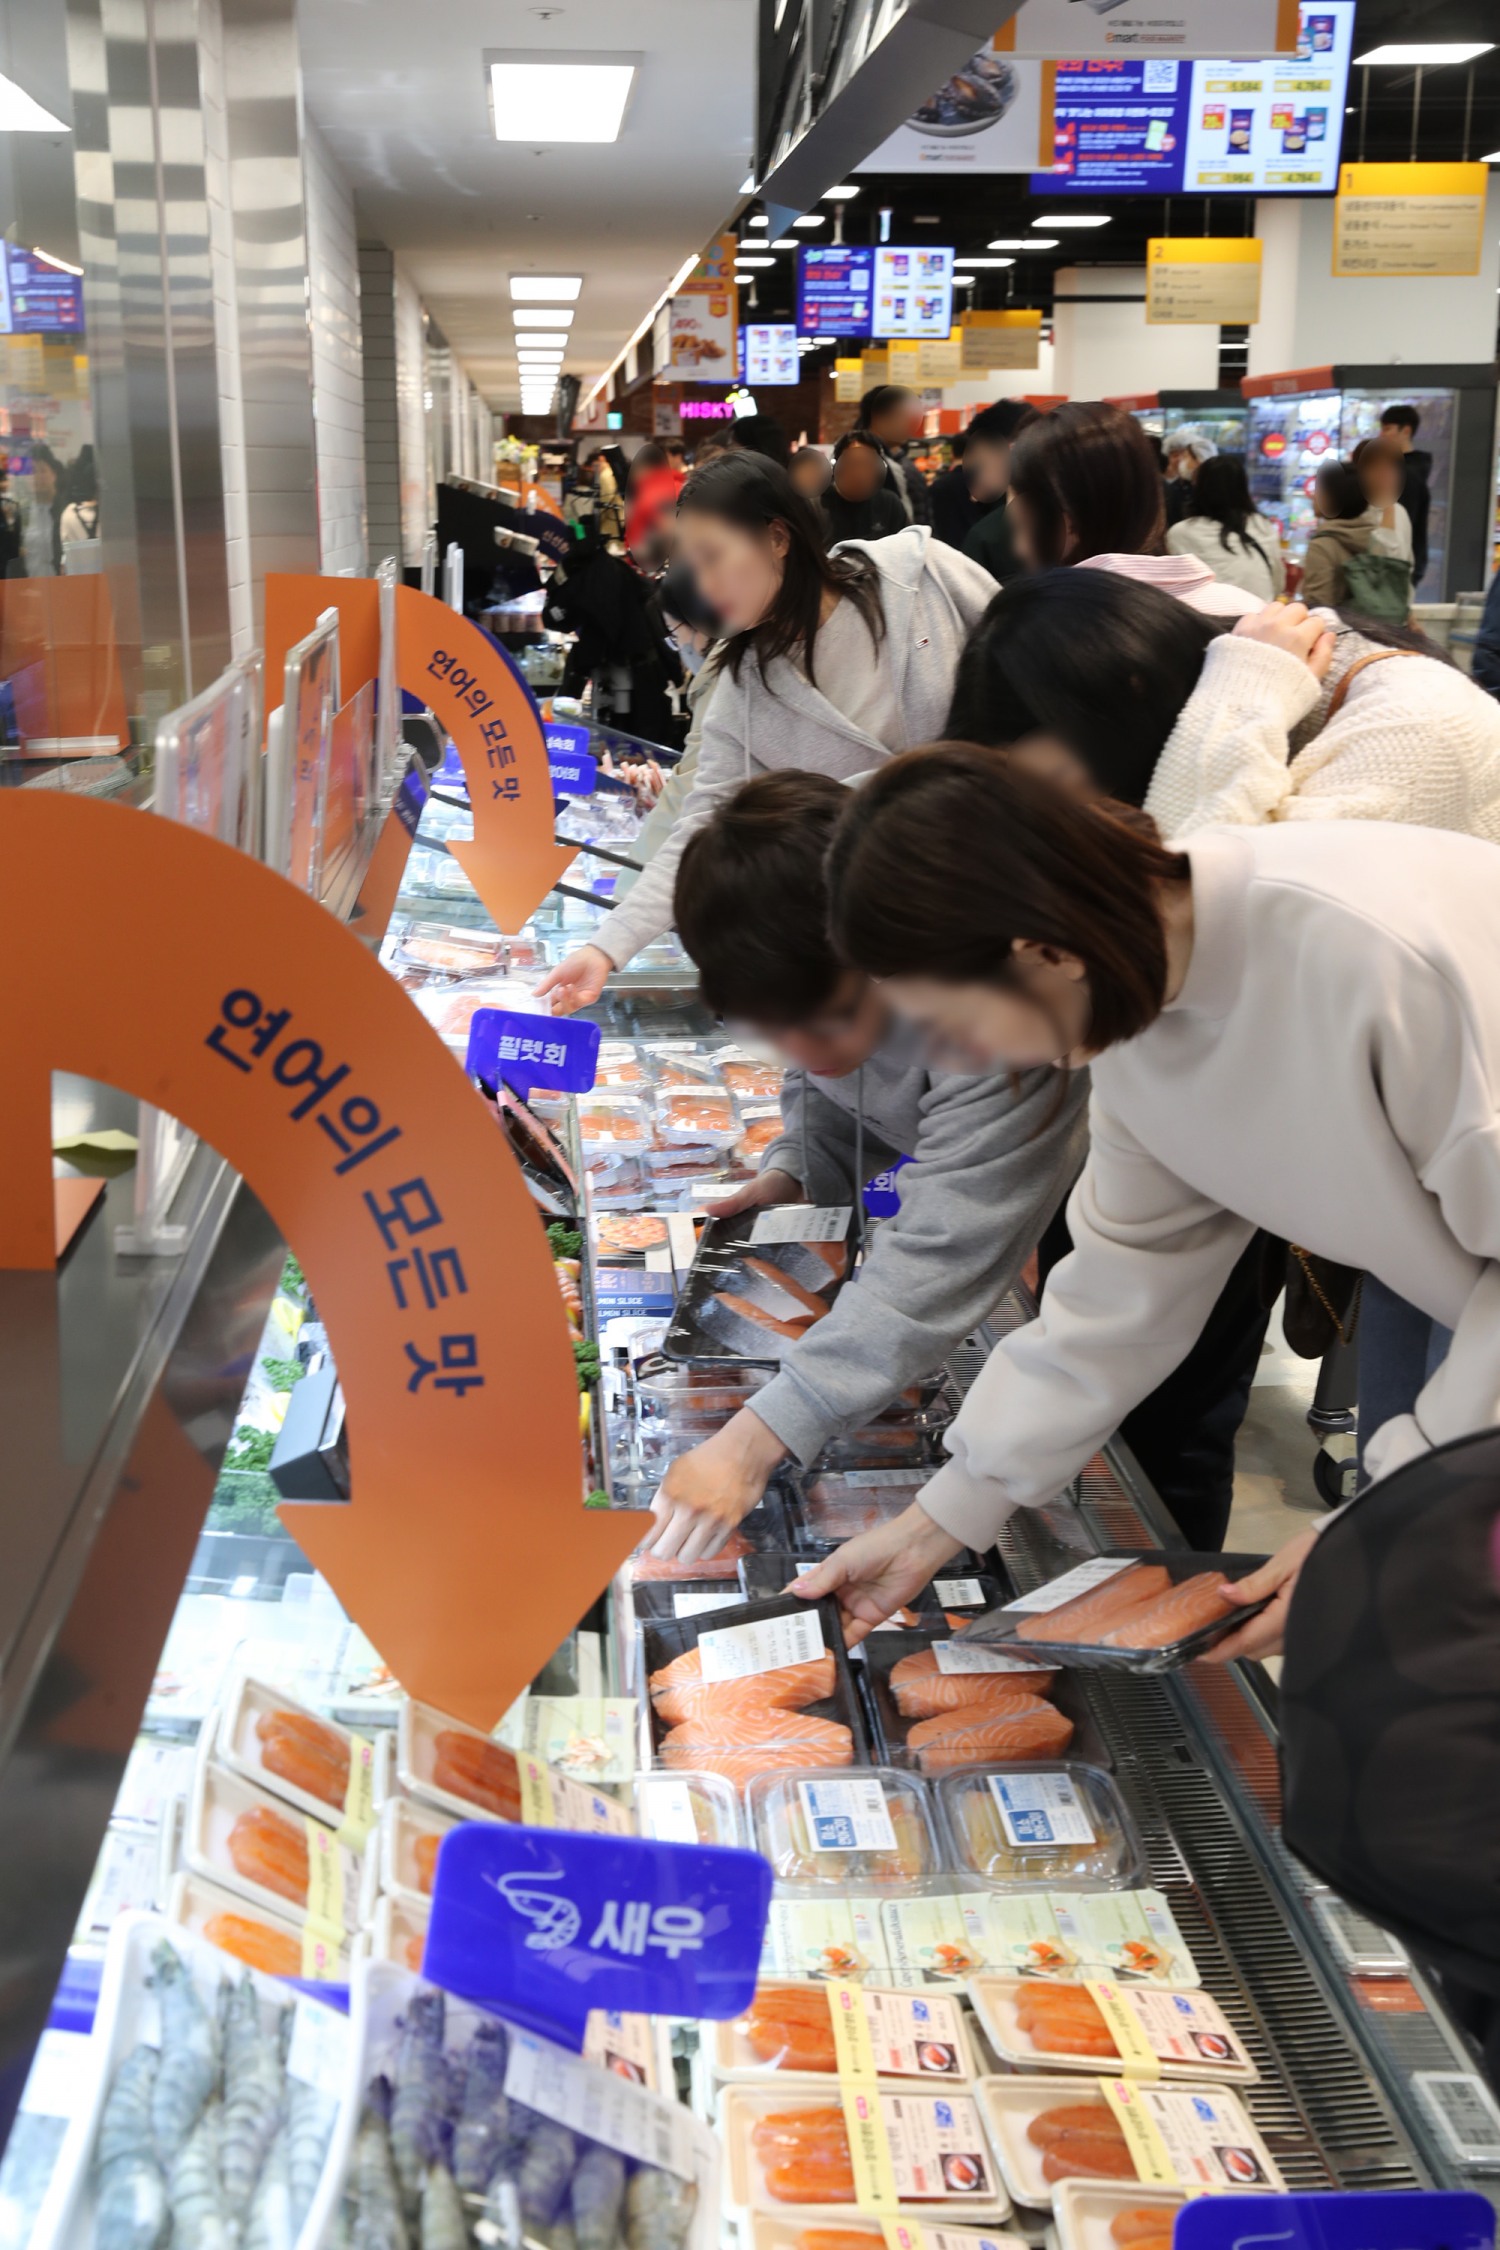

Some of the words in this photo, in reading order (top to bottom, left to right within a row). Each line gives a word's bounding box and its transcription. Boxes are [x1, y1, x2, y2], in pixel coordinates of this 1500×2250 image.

[1346, 173, 1353, 188] 1
[1154, 246, 1164, 259] 2
[426, 650, 494, 718] 연어의
[480, 719, 516, 769] 모든
[492, 777, 521, 801] 맛
[497, 1035, 567, 1067] 필렛회
[204, 988, 402, 1176] 연어의
[362, 1176, 469, 1310] 모든
[404, 1333, 485, 1397] 맛
[588, 1899, 704, 1959] 새우
